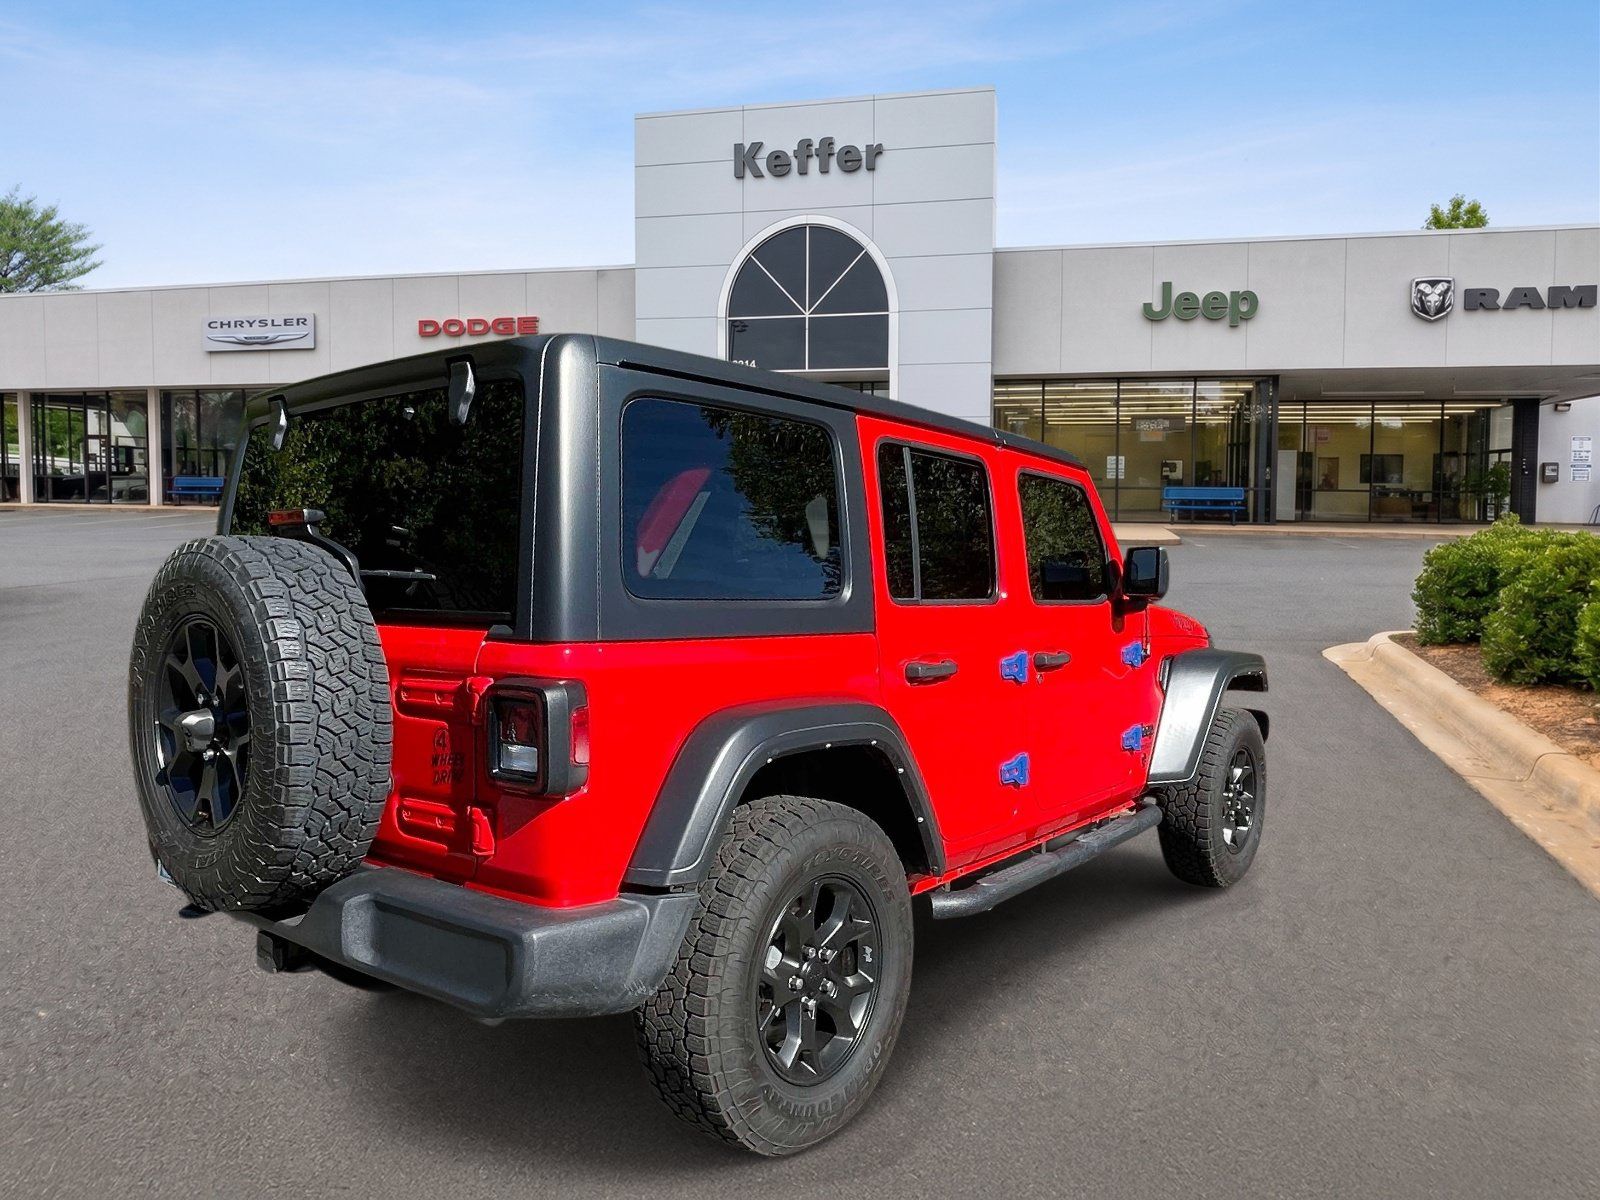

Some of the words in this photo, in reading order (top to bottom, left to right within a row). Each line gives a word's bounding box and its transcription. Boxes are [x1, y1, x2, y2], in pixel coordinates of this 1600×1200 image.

[734, 137, 883, 178] Keffer
[1143, 282, 1259, 327] Jeep
[1464, 285, 1598, 310] RAM
[208, 318, 308, 329] CHRYSLER
[418, 317, 539, 337] DODGE
